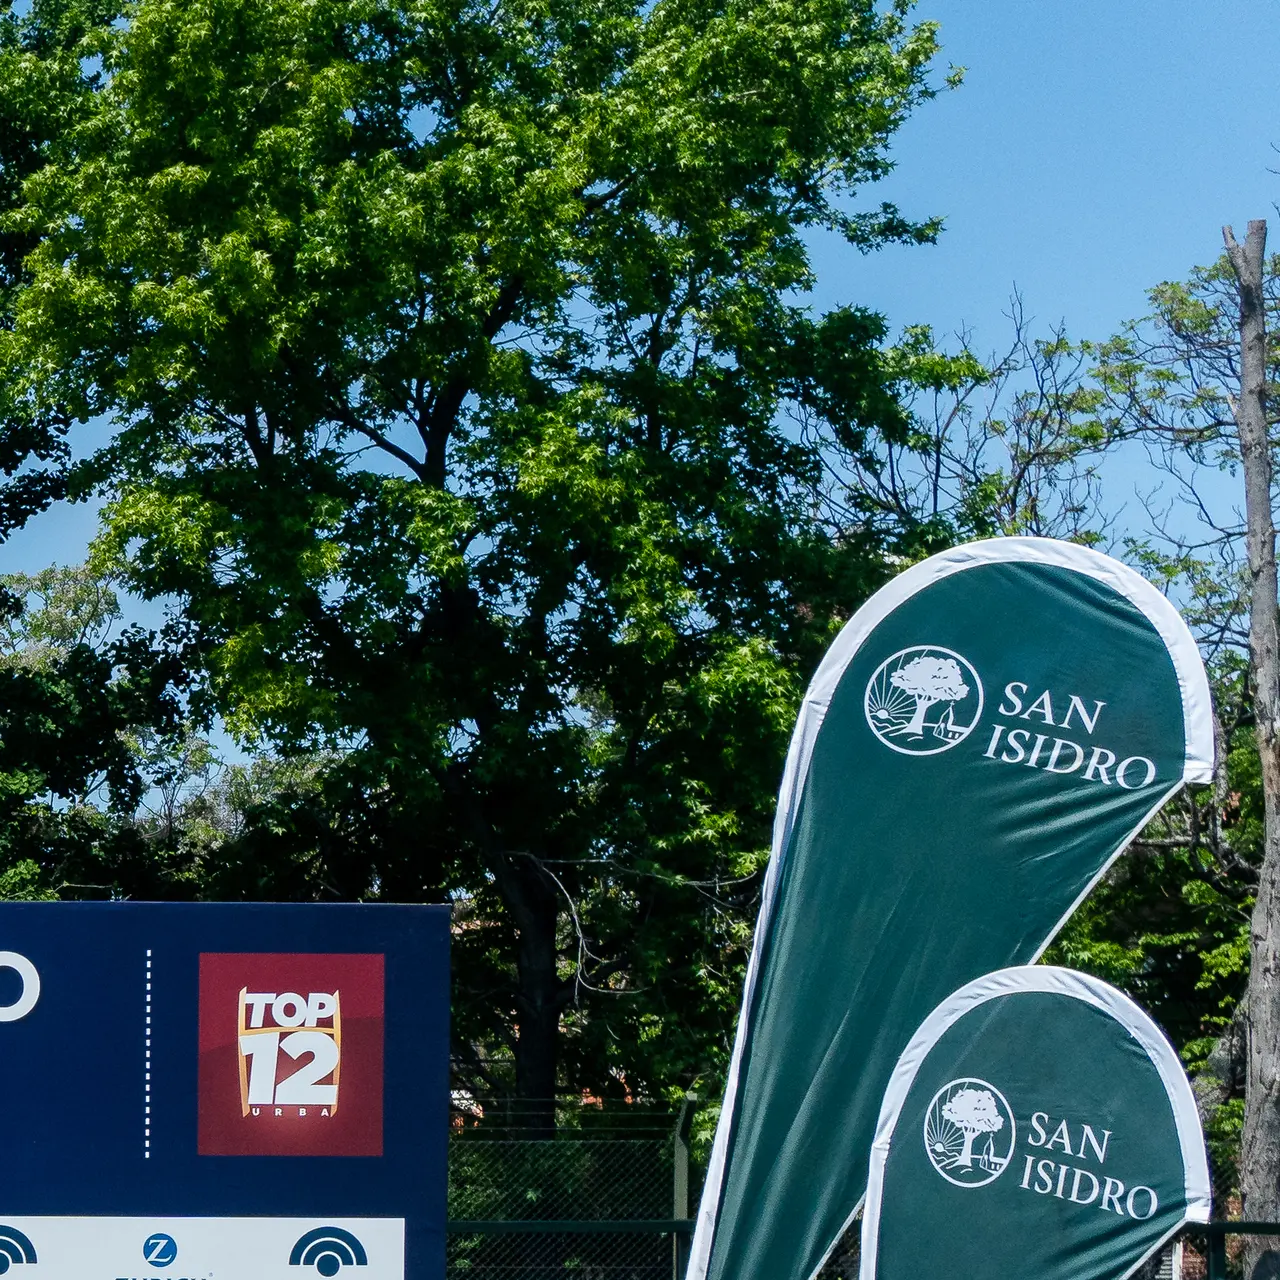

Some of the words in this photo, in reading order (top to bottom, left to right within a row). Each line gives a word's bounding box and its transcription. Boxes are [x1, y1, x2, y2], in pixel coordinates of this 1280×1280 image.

[998, 681, 1107, 735] SAN
[982, 723, 1156, 791] ISIDRO
[243, 992, 339, 1029] TOP
[239, 1030, 340, 1106] 12
[251, 1107, 331, 1117] URBA
[1027, 1111, 1113, 1164] SAN
[1019, 1154, 1158, 1221] ISIDRO
